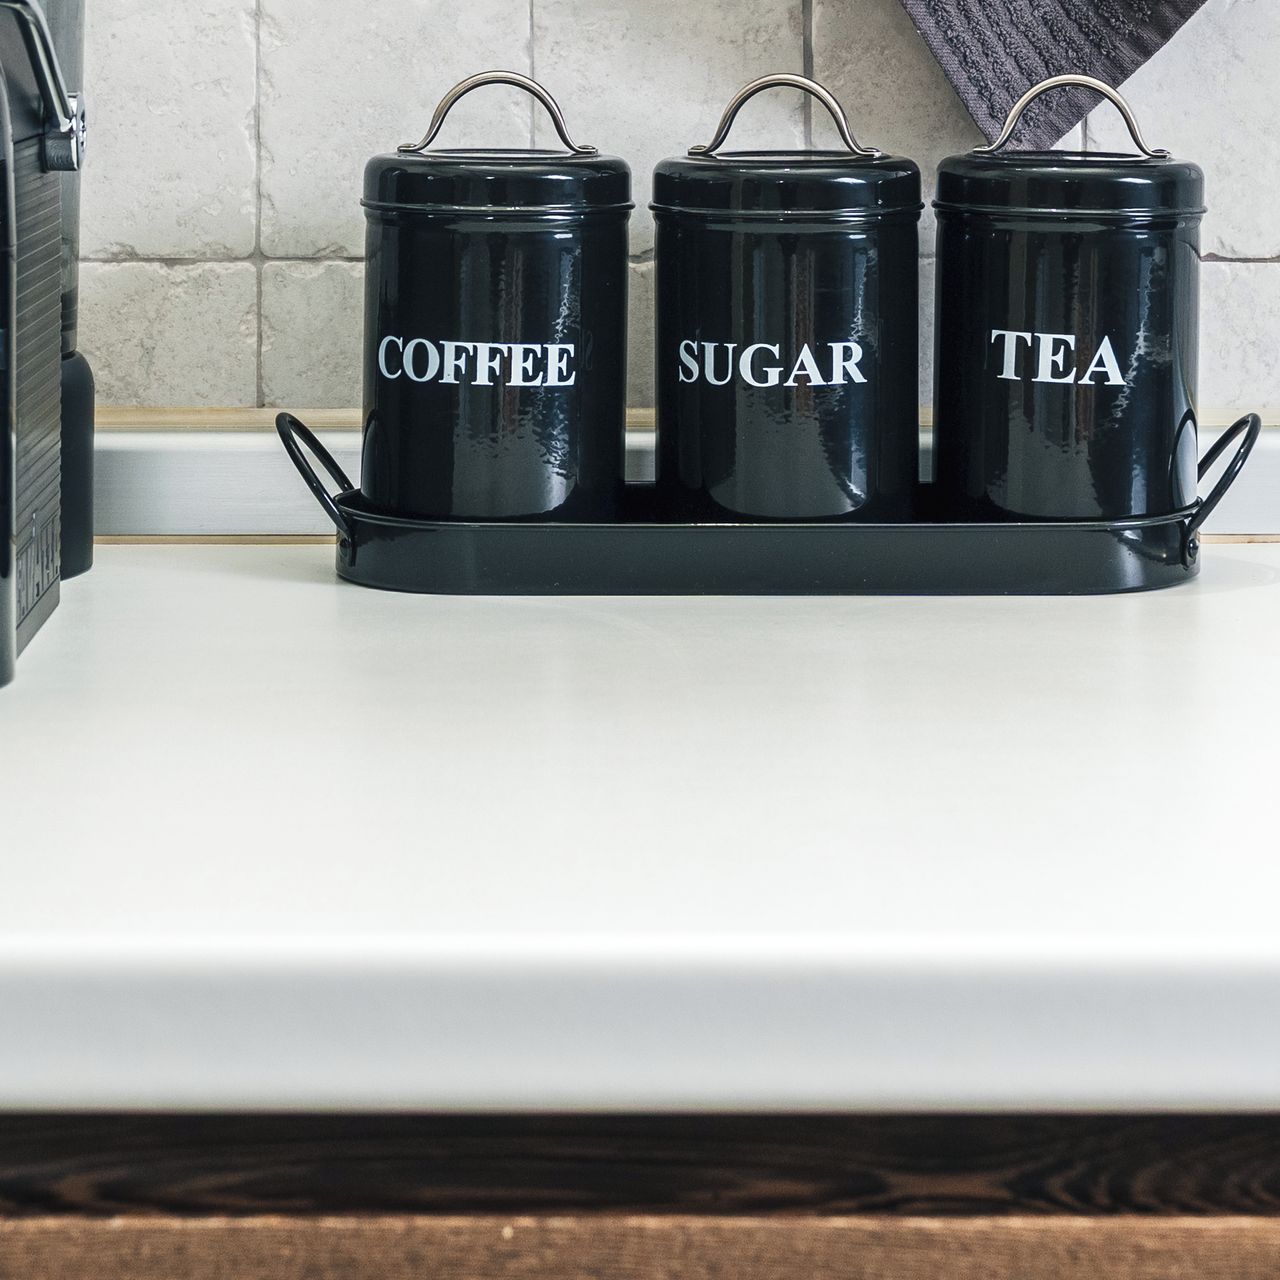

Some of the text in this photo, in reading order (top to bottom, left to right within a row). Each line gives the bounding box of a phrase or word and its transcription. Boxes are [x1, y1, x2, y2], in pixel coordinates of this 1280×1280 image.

[378, 335, 576, 387] COFFEE
[678, 339, 868, 388] SUGAR
[991, 329, 1128, 387] TEA
